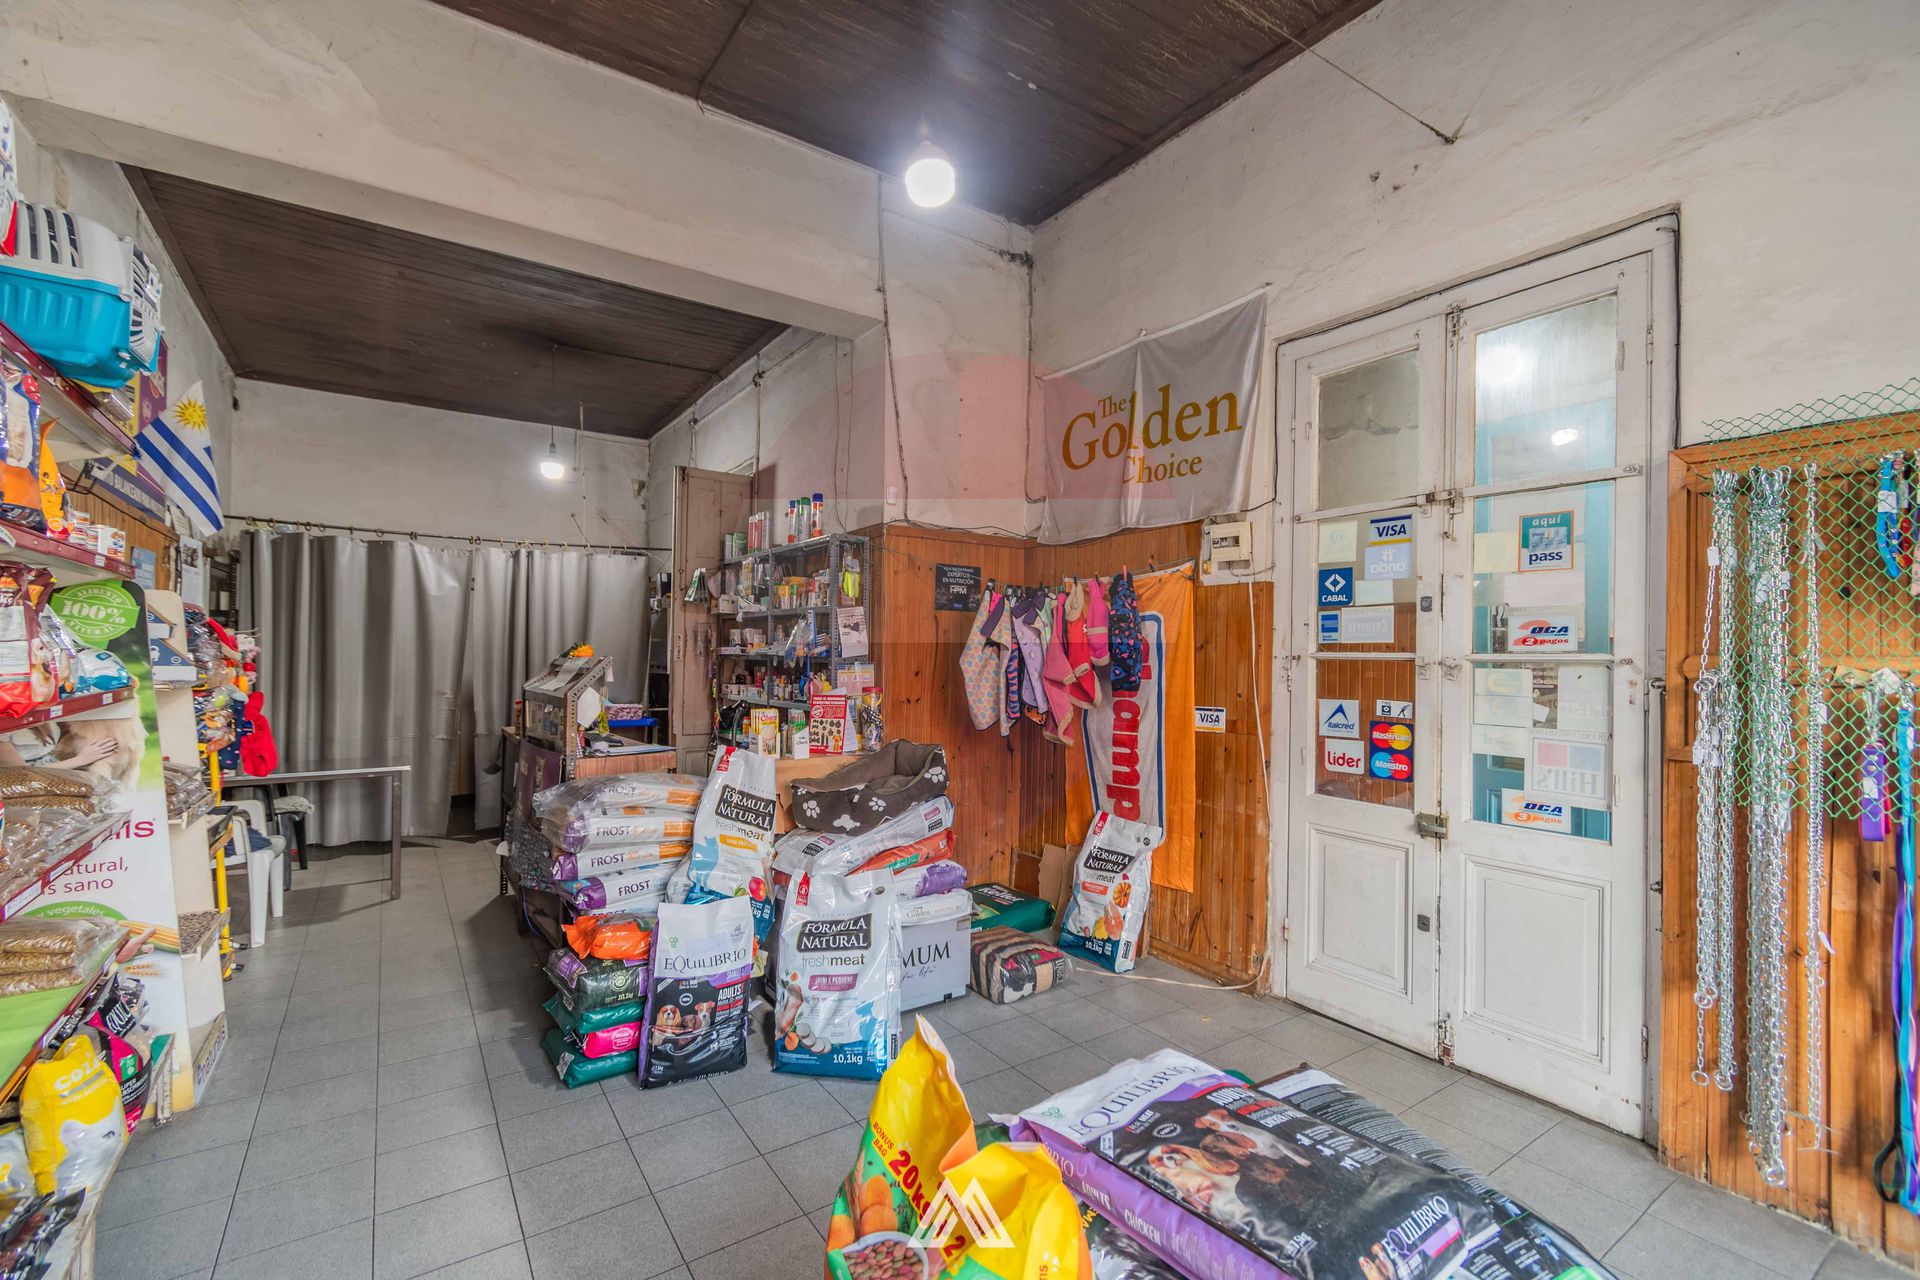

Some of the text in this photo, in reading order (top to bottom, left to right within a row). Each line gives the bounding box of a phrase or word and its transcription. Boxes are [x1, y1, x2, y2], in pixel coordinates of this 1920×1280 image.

[1097, 394, 1127, 419] The
[1061, 384, 1243, 471] Golden
[1122, 452, 1203, 485] Choice
[1375, 523, 1407, 538] VISA
[1528, 551, 1563, 565] pass
[1321, 594, 1348, 603] CABAL
[61, 600, 127, 625] 100%
[62, 617, 114, 636] ATURAL
[1530, 626, 1569, 634] OCA
[1199, 713, 1220, 724] VISA
[1372, 731, 1412, 742] MasterCard
[1374, 759, 1409, 771] Maestro
[723, 787, 774, 815] FÓRMULA
[1523, 802, 1563, 814] OCA
[717, 801, 771, 829] NATURAL
[596, 825, 631, 837] FROST
[63, 856, 129, 876] atural,
[590, 852, 625, 868] FROST
[1086, 859, 1124, 873] NATURAL
[63, 877, 114, 894] sano
[618, 879, 651, 897] FROST
[804, 917, 868, 934] FÓRMULA
[800, 933, 868, 950] NATURAL
[833, 1054, 863, 1065] 10,1kg
[873, 1121, 895, 1151] BONUS
[873, 1138, 888, 1157] BAG
[1081, 1180, 1112, 1212] ADULTS
[1124, 1209, 1162, 1247] CHICKEN
